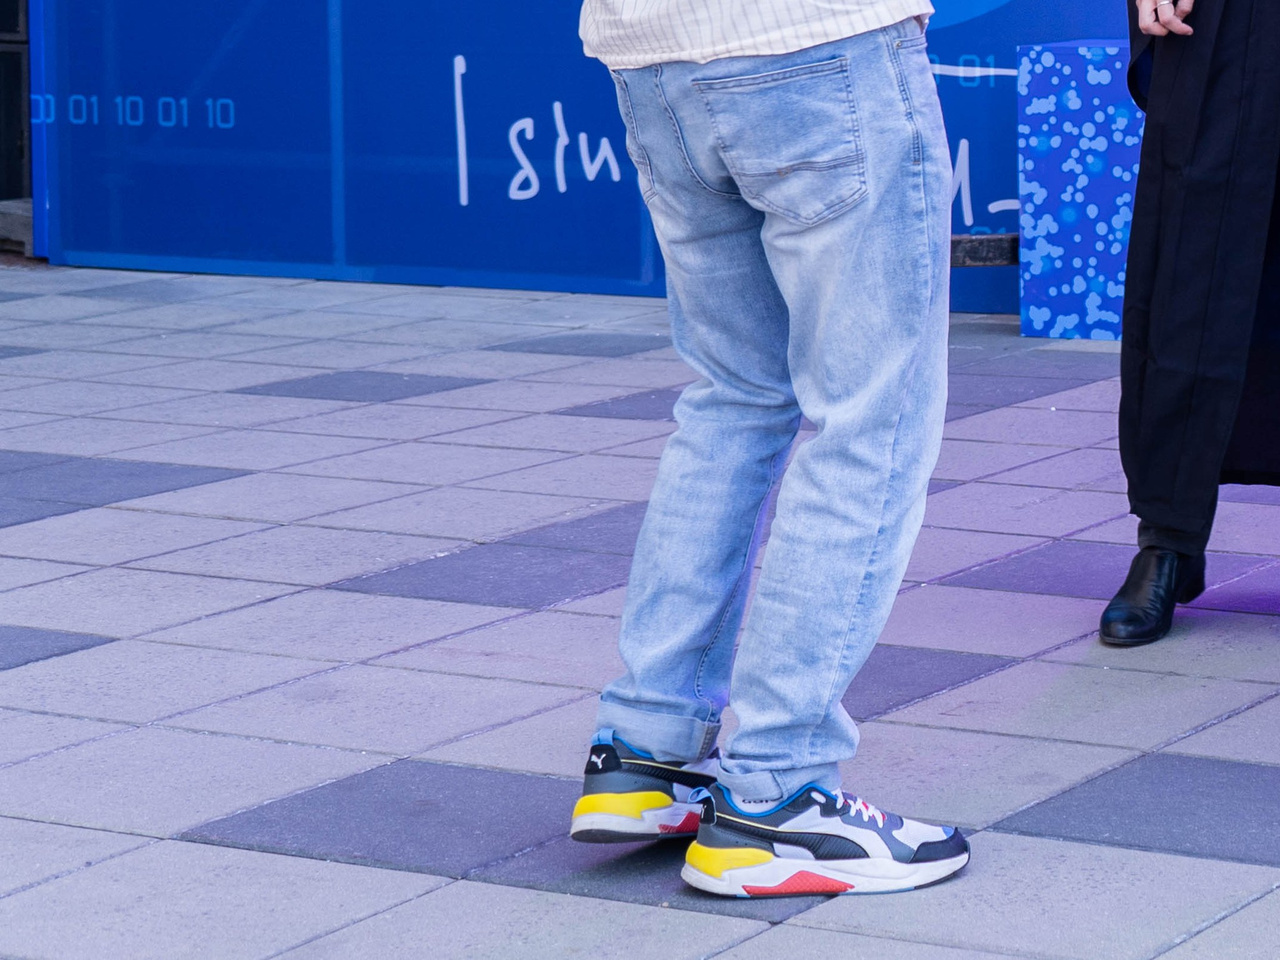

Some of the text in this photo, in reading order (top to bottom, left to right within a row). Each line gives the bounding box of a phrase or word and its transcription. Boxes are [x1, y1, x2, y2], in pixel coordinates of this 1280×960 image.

[69, 94, 99, 125] 01
[115, 95, 144, 126] 10
[158, 97, 188, 127] 01
[205, 98, 235, 129] 10
